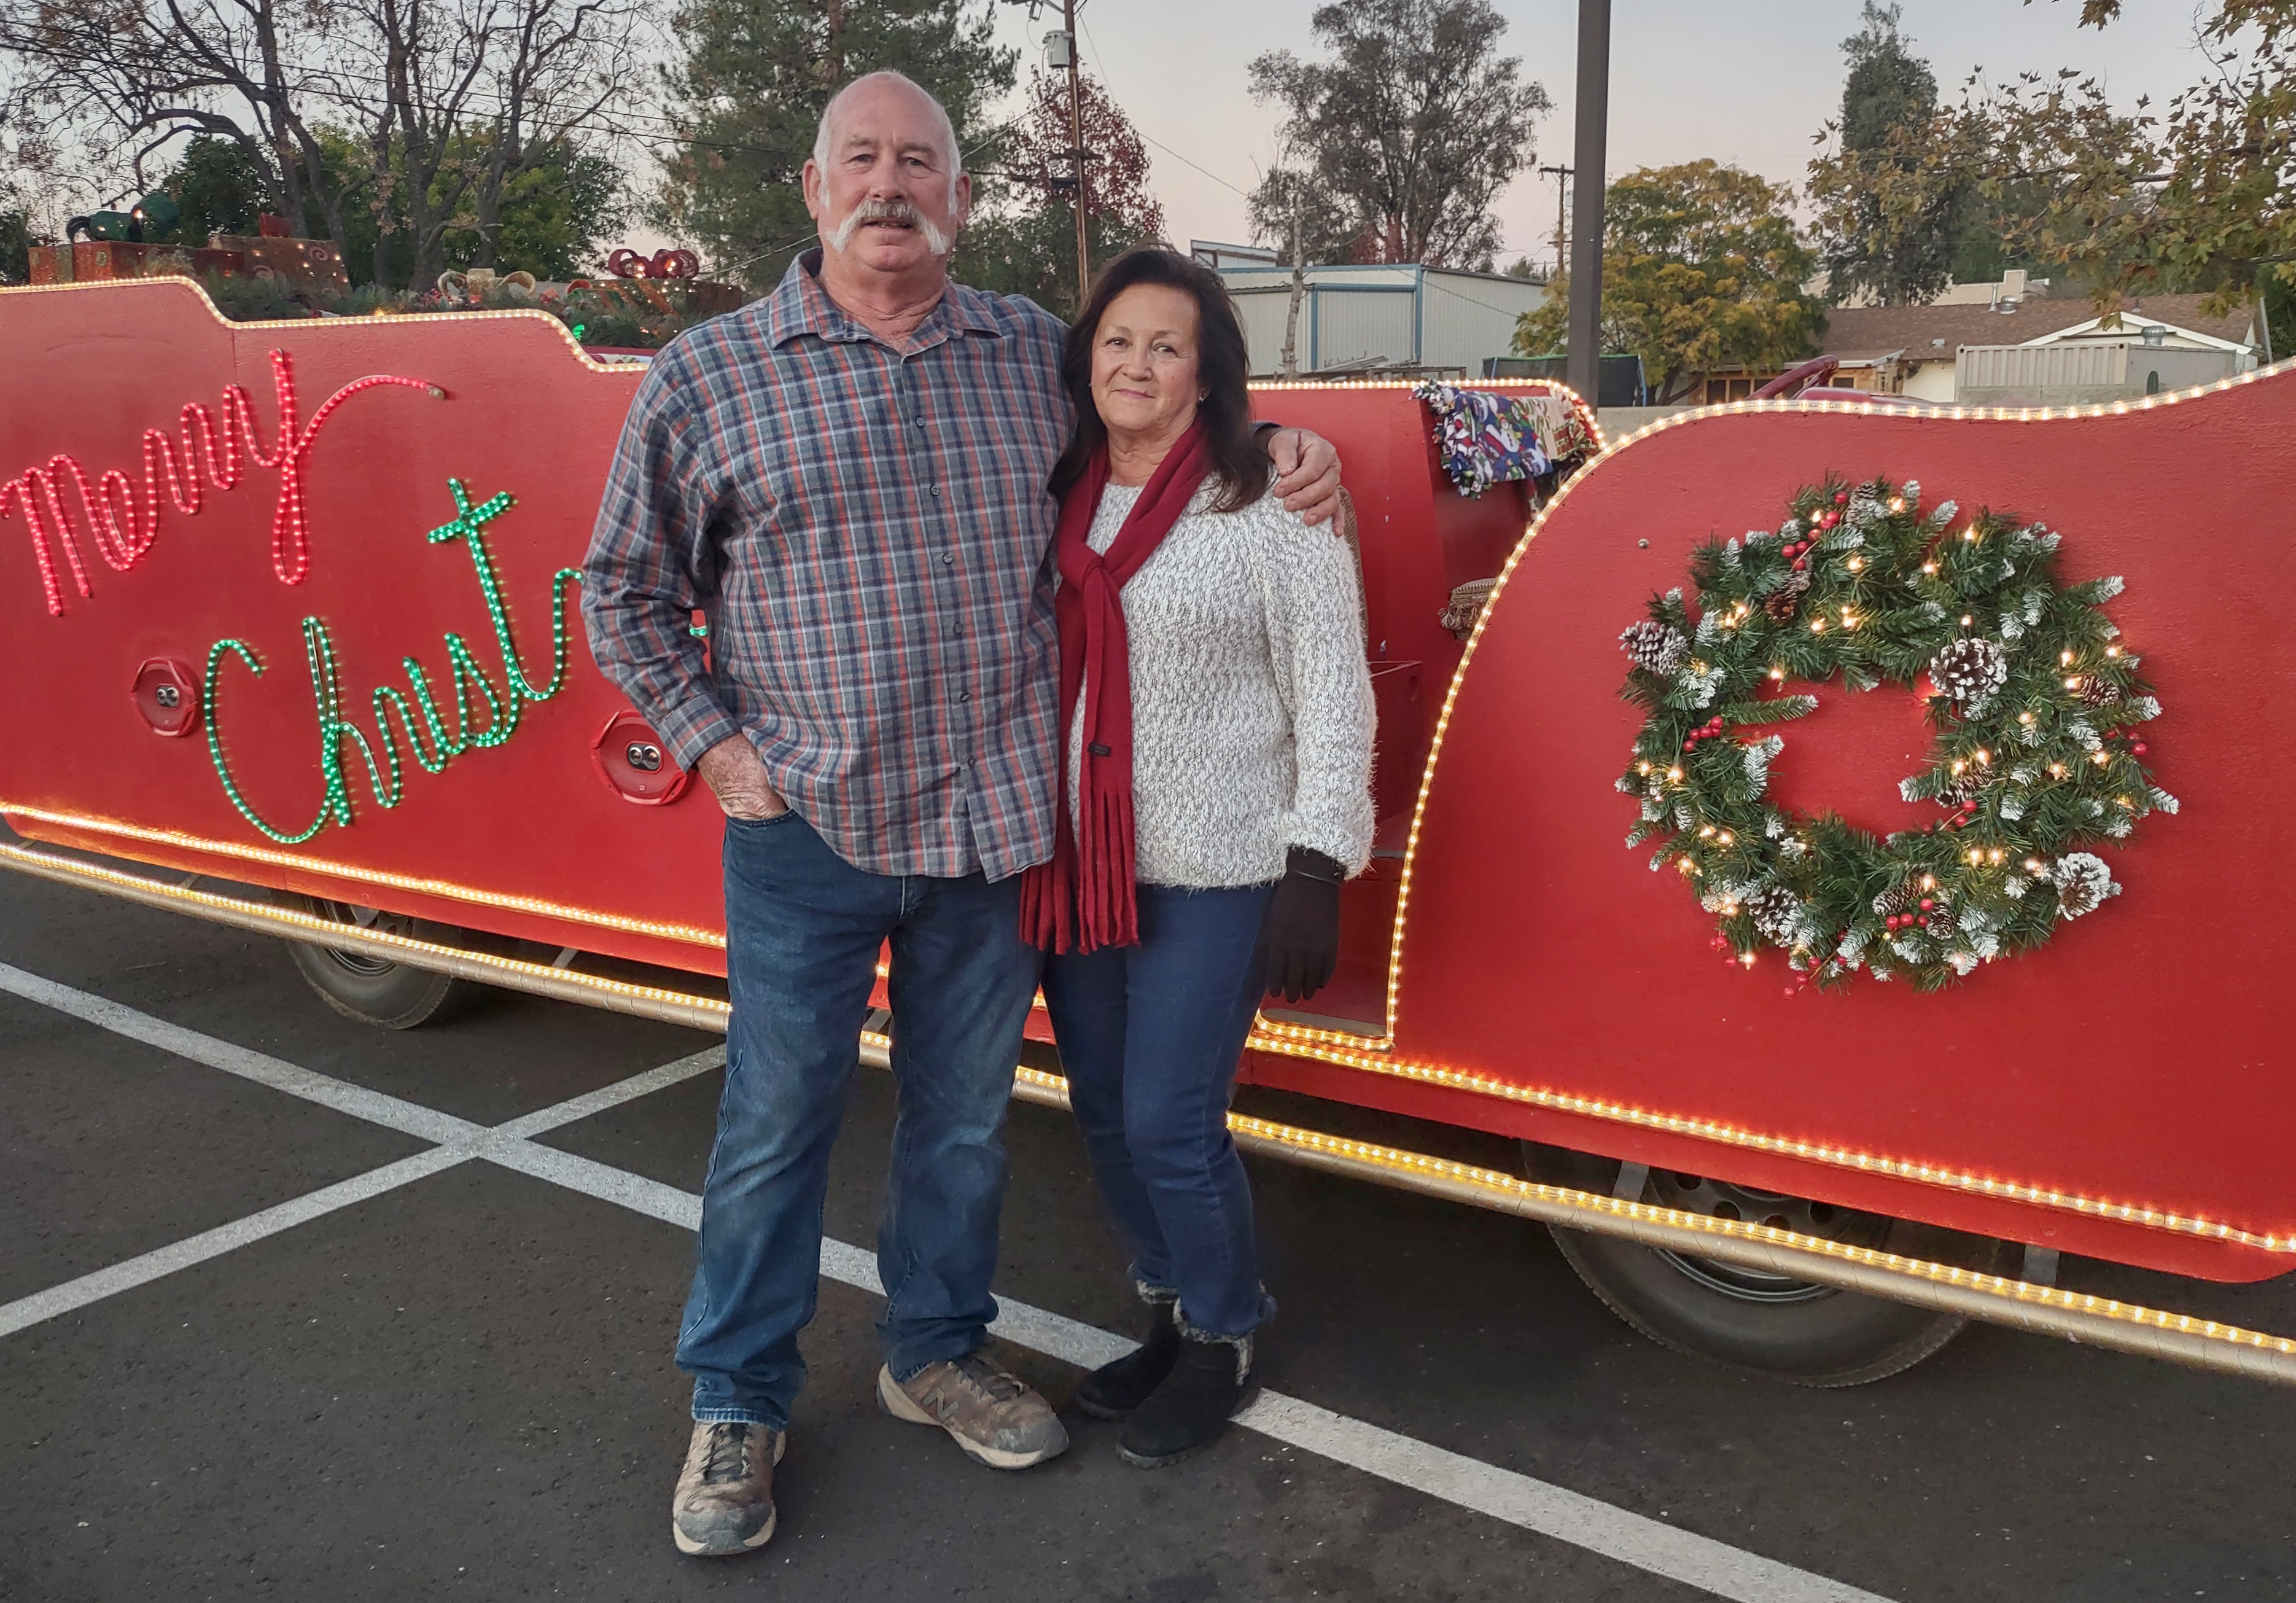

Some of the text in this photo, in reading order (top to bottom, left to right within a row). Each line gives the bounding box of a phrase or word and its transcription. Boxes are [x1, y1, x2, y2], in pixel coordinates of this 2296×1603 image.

[0, 348, 445, 616] Merry
[205, 477, 585, 844] Christ
[922, 1387, 960, 1421] N
